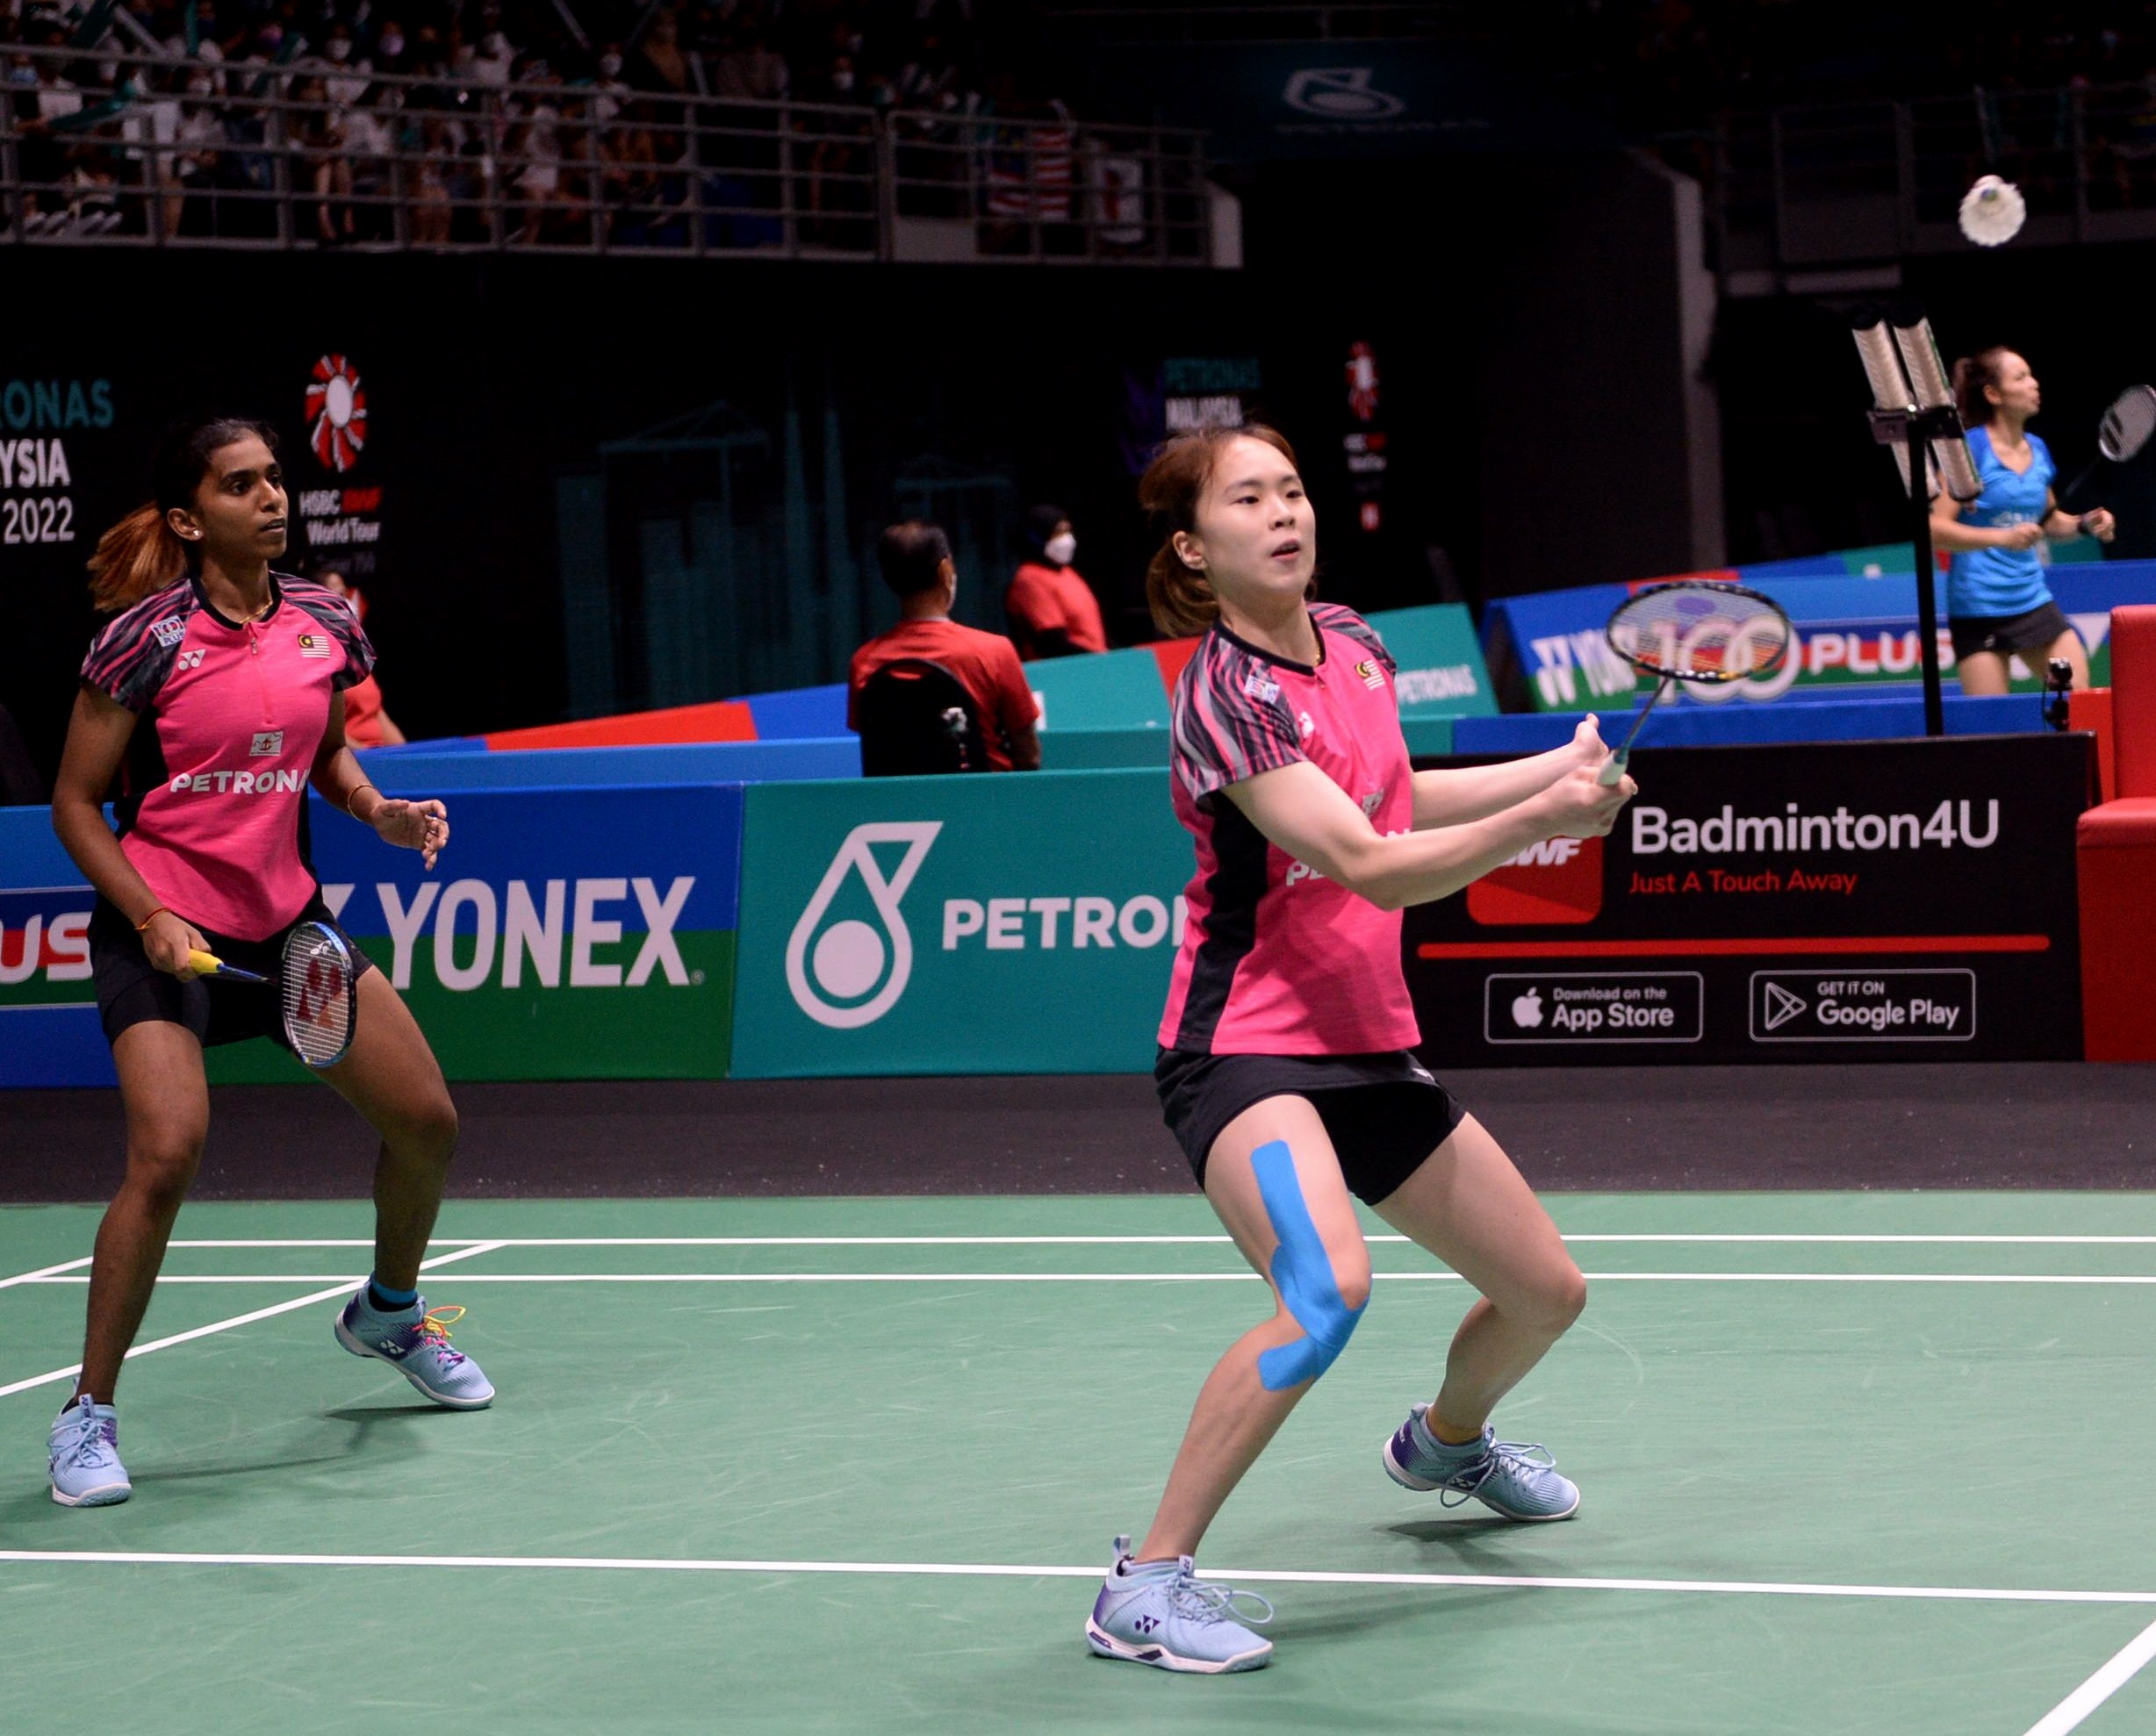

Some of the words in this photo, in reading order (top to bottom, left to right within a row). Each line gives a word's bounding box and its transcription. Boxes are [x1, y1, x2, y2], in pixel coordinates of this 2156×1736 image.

[0, 378, 115, 431] ONAS
[3, 496, 75, 544] 2022
[307, 518, 349, 546] World
[349, 517, 381, 542] Tour
[1632, 799, 1999, 854] Badminton4U
[1502, 837, 1583, 866] WF
[1630, 872, 1675, 894] Just
[1682, 872, 1702, 893] A
[1707, 869, 1780, 893] Touch
[1786, 869, 1858, 895] Away
[376, 876, 696, 992] YONEX
[1553, 986, 1620, 1001] Download
[1623, 989, 1641, 1000] on
[1643, 986, 1667, 1000] the
[1817, 981, 1845, 996] GET
[1847, 981, 1861, 995] IT
[1862, 980, 1885, 995] ON
[1551, 1003, 1603, 1032] App
[1607, 1002, 1675, 1027] Store
[1816, 999, 1905, 1030] Google
[1909, 999, 1960, 1030] Play
